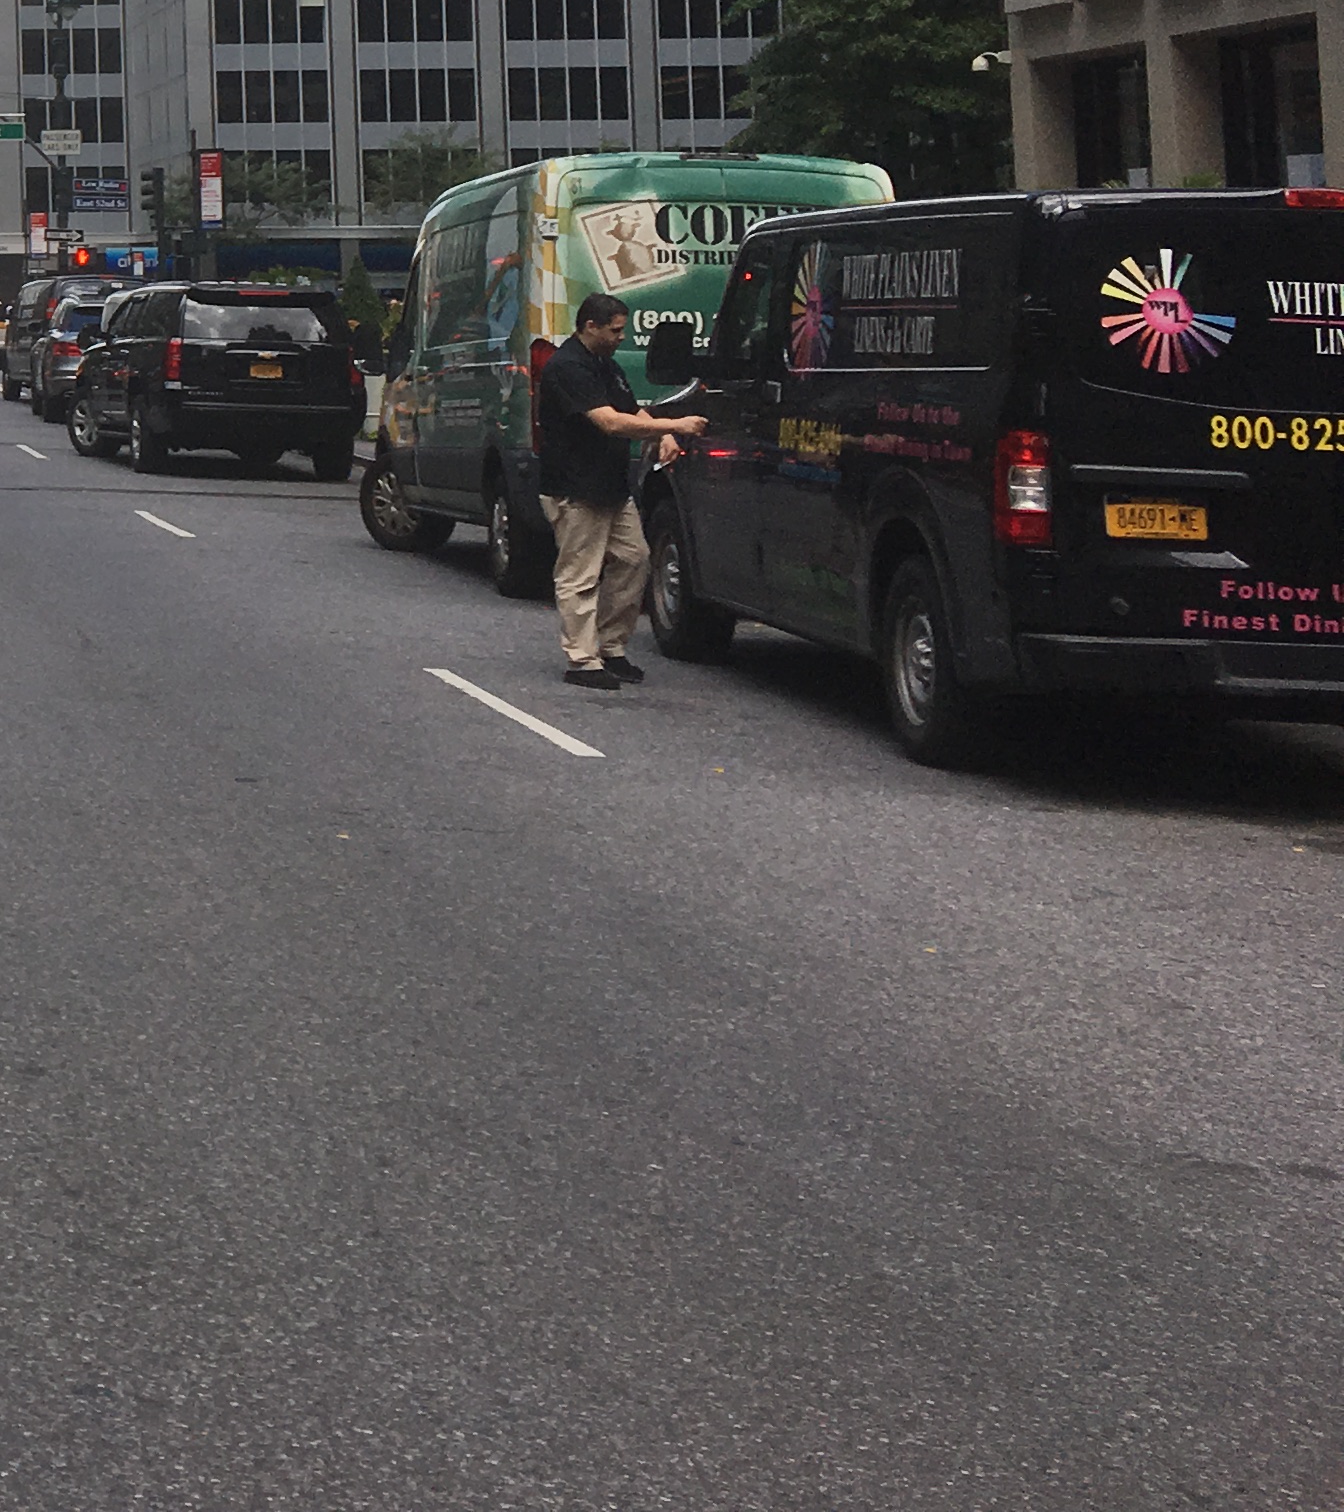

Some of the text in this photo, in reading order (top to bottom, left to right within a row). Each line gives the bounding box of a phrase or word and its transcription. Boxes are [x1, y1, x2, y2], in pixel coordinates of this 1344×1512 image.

[632, 310, 704, 335] (800)
[1147, 300, 1189, 323] WPL
[1220, 579, 1320, 602] Follow
[1182, 609, 1344, 634] Finest Din
